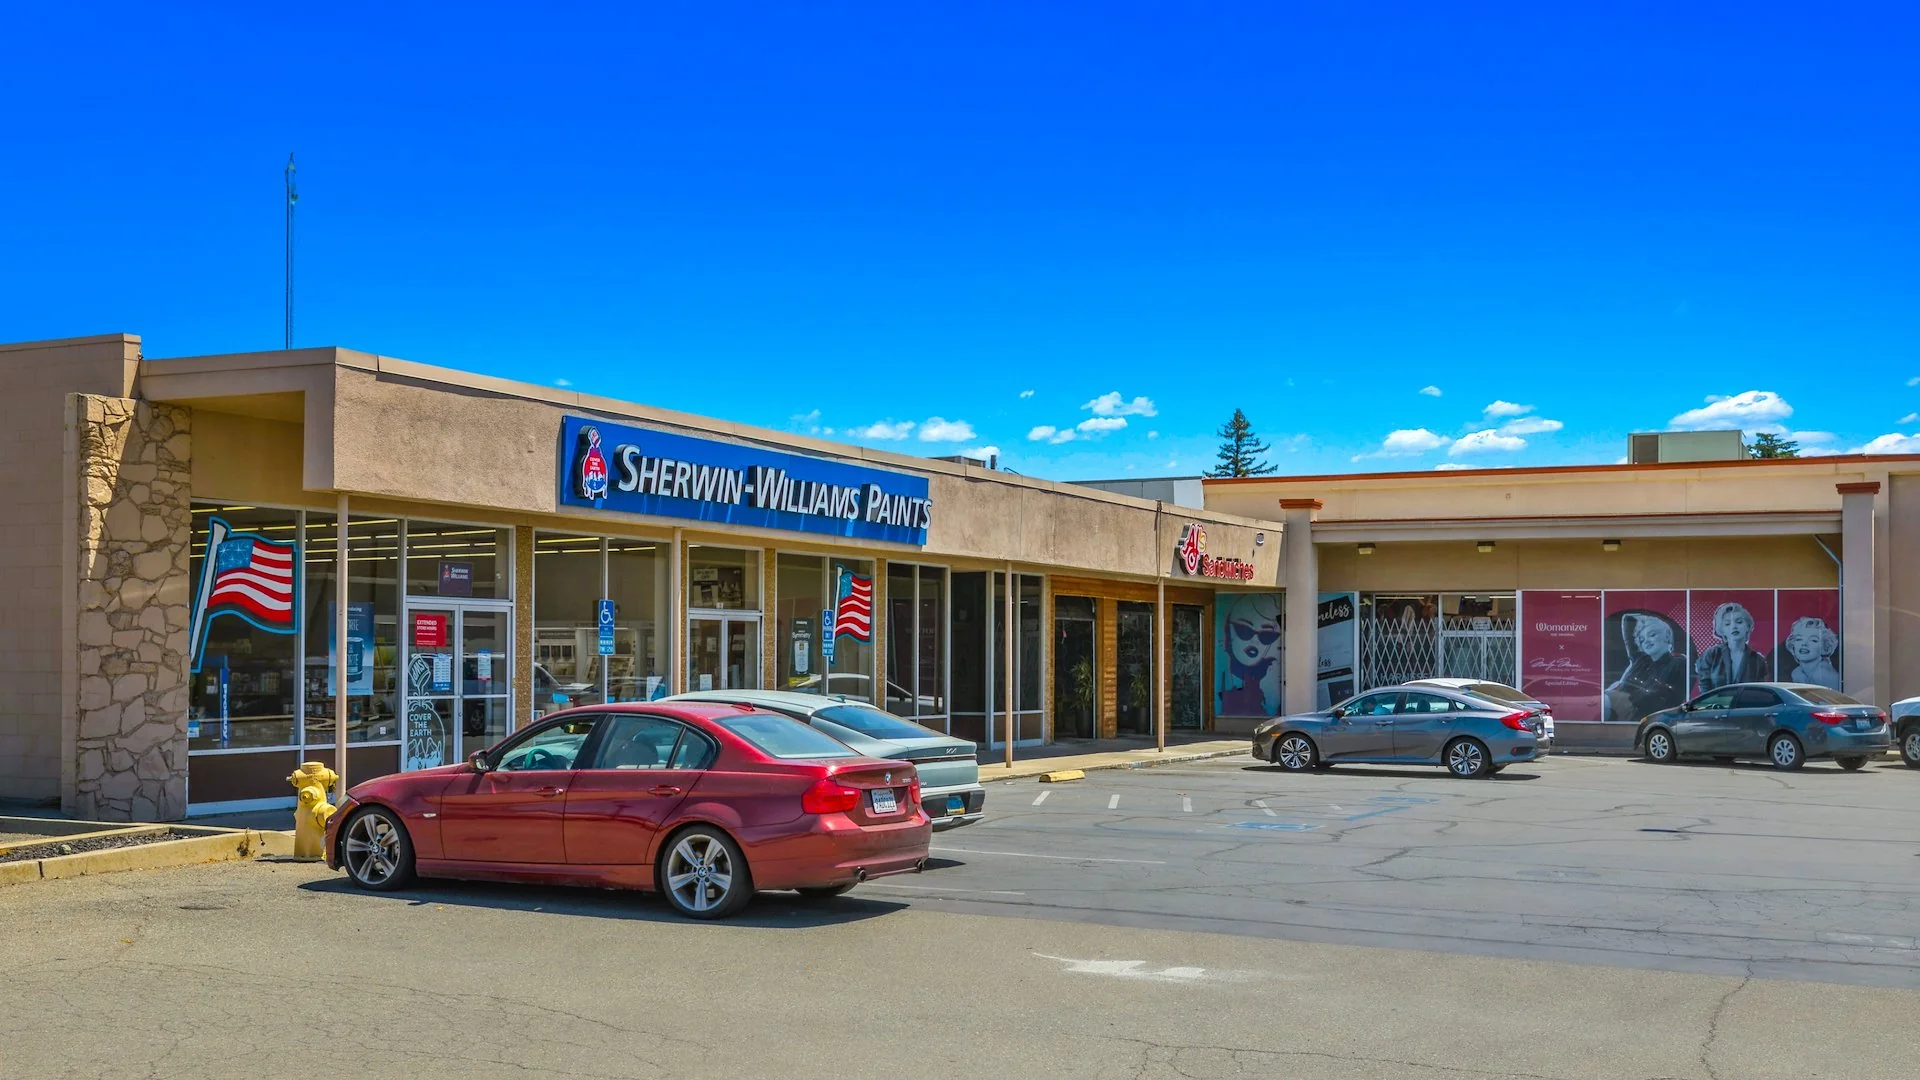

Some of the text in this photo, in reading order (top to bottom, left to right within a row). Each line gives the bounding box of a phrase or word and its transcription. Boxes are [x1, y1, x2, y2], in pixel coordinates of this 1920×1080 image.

[618, 444, 933, 529] SHERWIN-WILLIAMS PAINTS
[1202, 554, 1255, 580] Sandwiches
[1535, 622, 1588, 632] Womanizer
[409, 713, 432, 721] COVER
[414, 721, 428, 729] THE
[409, 729, 432, 737] EARTH
